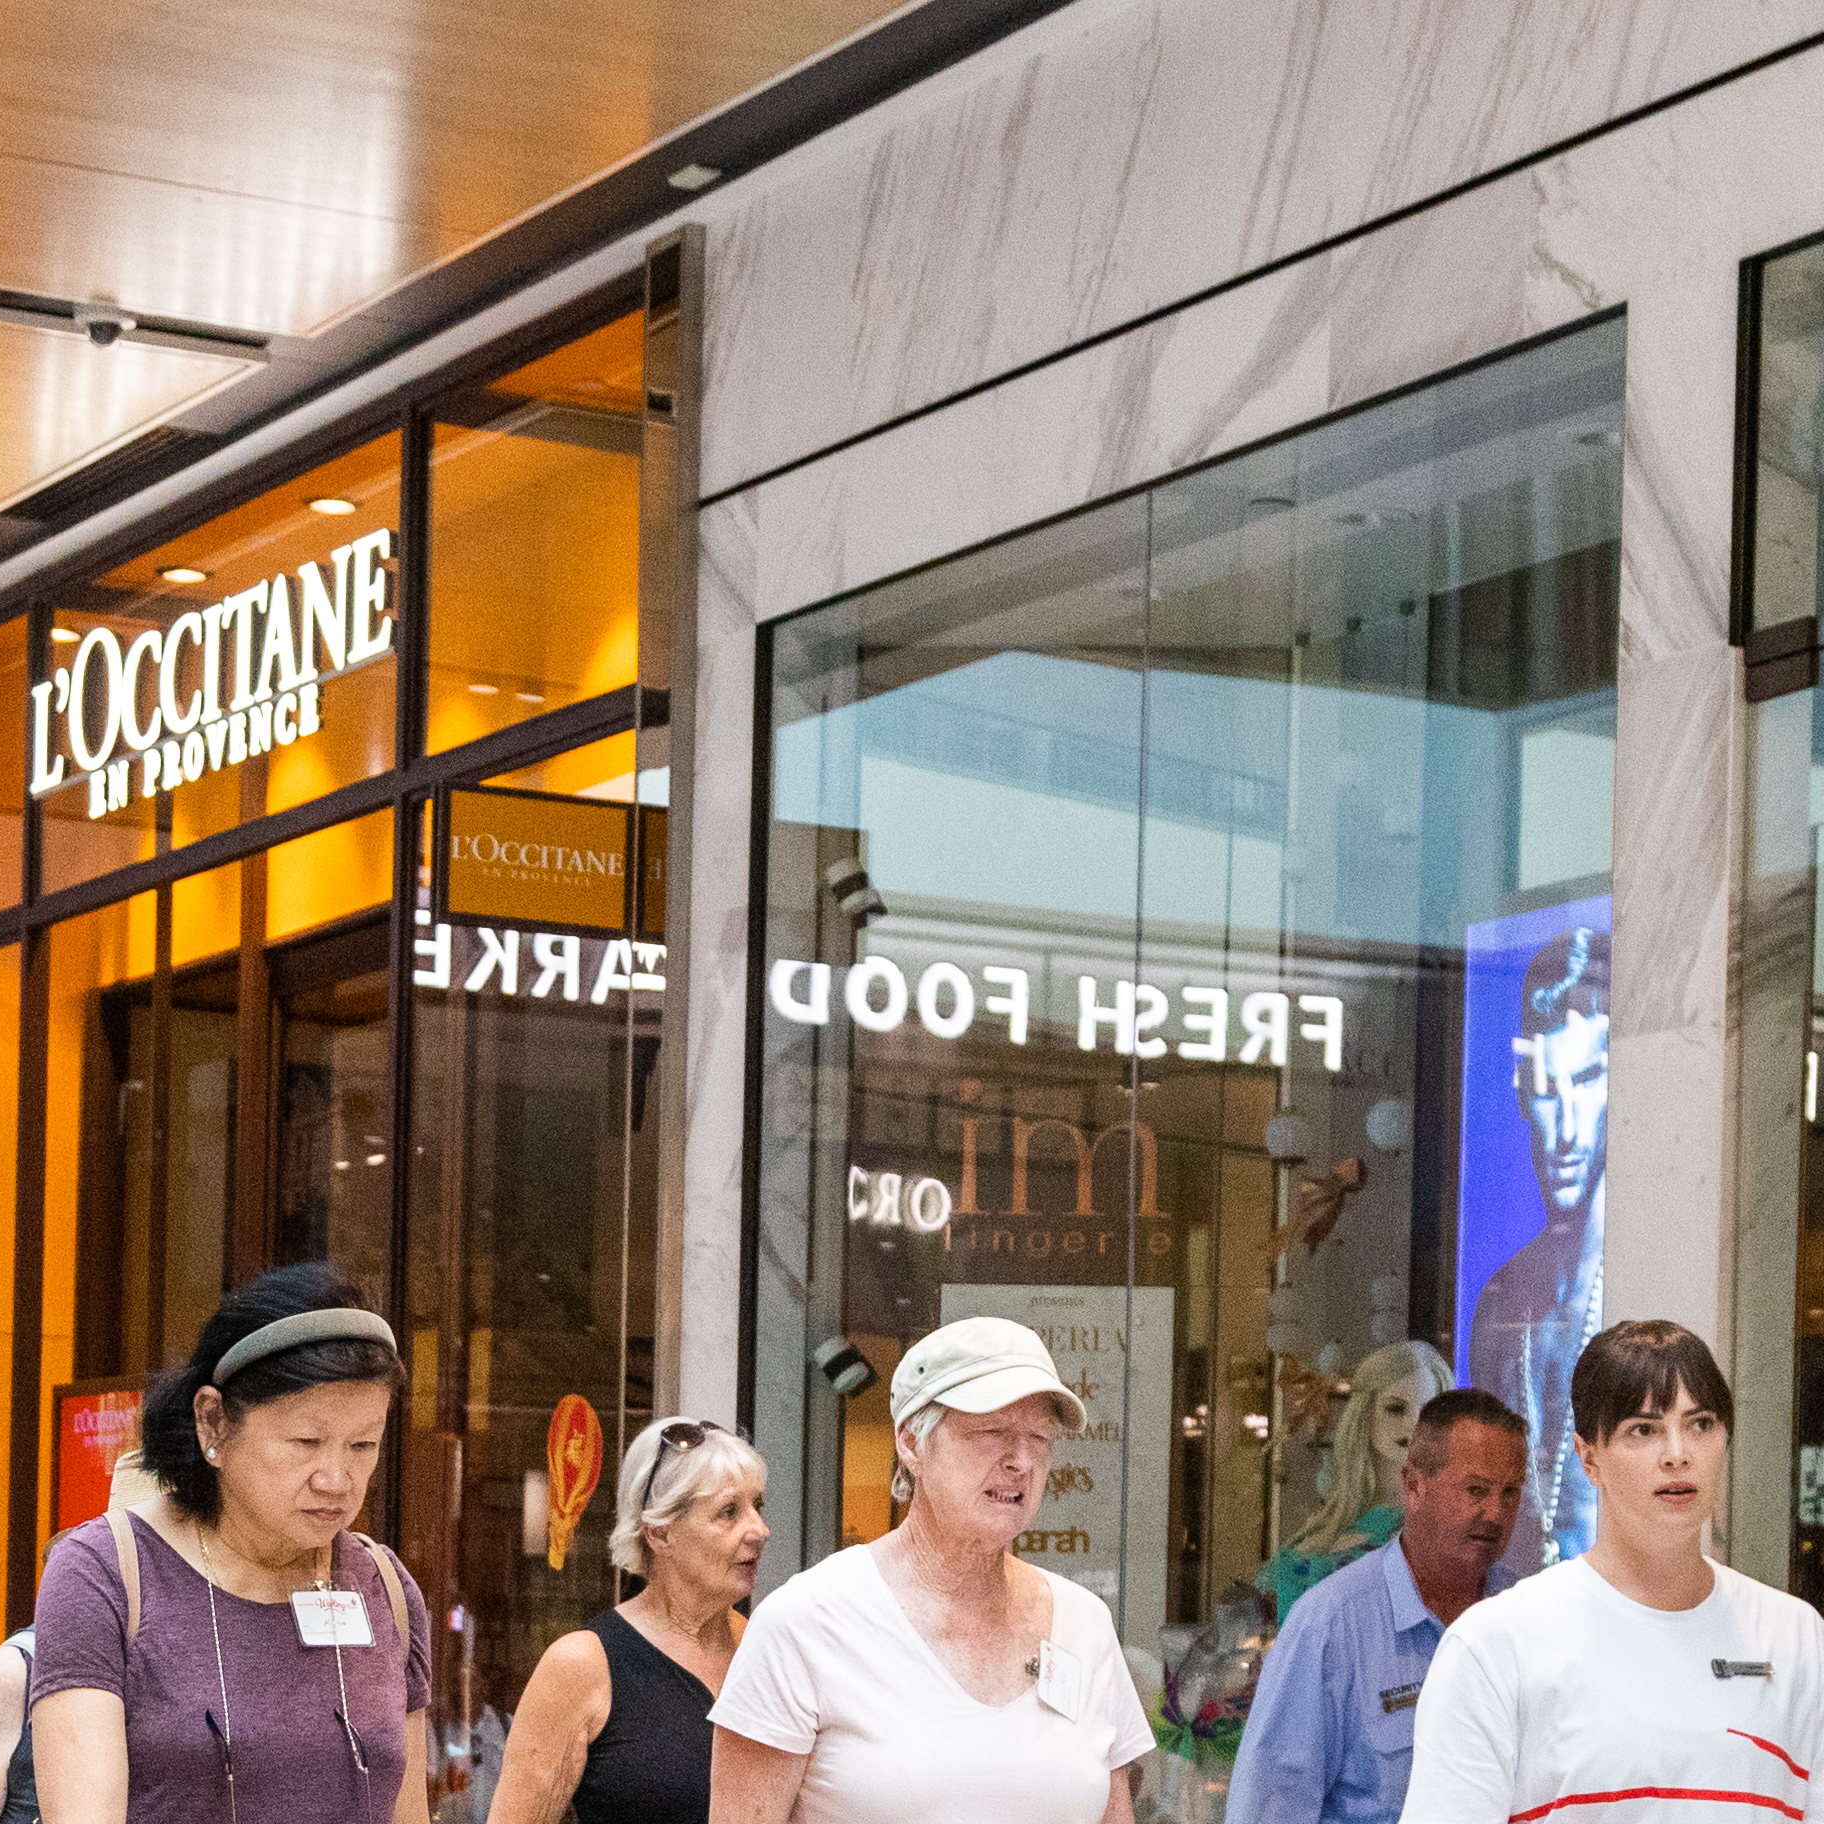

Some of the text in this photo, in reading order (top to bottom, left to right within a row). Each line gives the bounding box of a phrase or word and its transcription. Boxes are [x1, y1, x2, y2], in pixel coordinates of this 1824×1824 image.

[31, 528, 392, 794] L'OCCITANE
[89, 683, 319, 819] EN PROVENCE
[451, 833, 625, 876] L'OCCITANE
